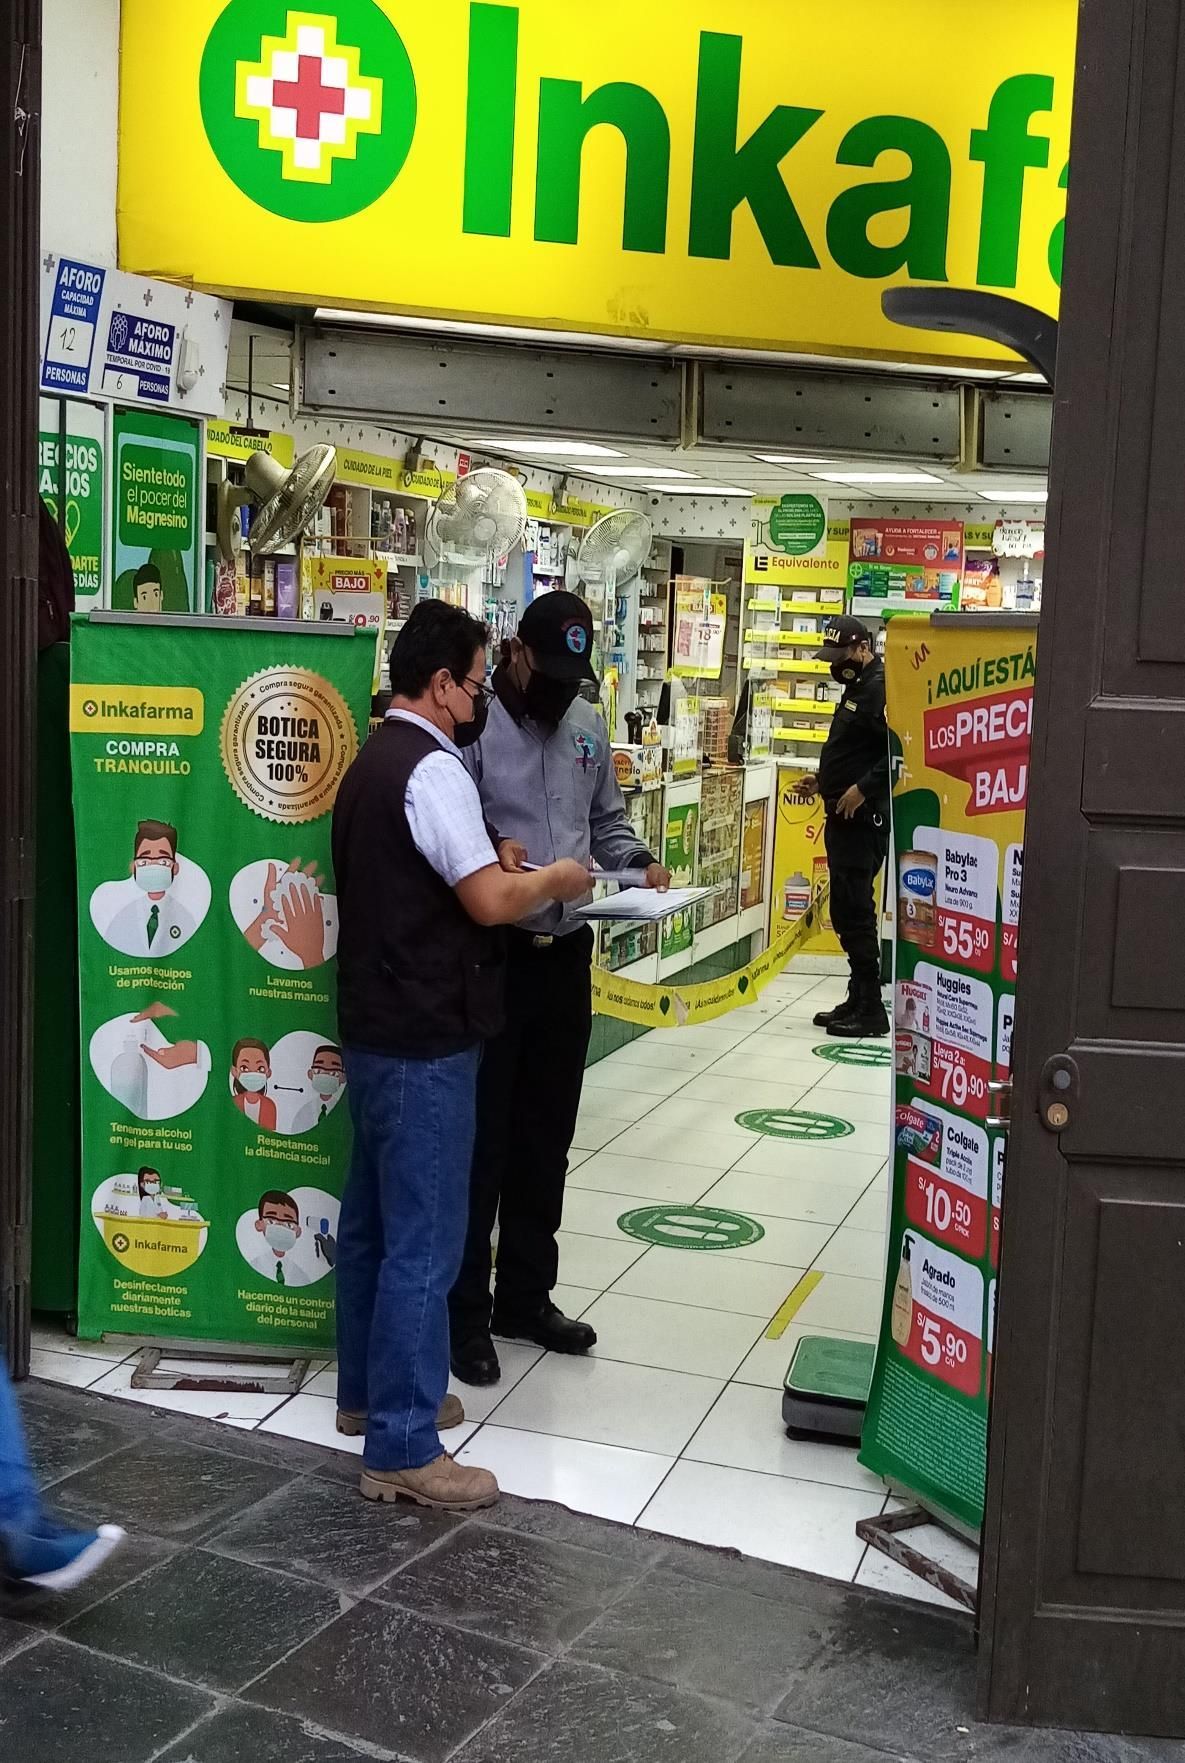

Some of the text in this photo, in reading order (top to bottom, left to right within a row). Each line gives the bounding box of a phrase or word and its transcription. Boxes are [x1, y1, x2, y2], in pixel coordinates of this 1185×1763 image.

[462, 2, 1069, 288] Inkaf
[59, 266, 101, 294] AFORO
[61, 290, 94, 306] CAPACIDAD
[63, 304, 87, 318] MÁXIMA
[59, 327, 75, 351] 12
[133, 321, 170, 342] AFORO
[128, 336, 171, 361] MÁXIMO
[106, 354, 134, 367] TEMPORAL
[134, 359, 146, 370] POR
[146, 361, 162, 373] COVID
[45, 366, 87, 386] PERSONAS
[116, 374, 123, 390] 6
[139, 380, 169, 395] PERSONAS
[230, 434, 242, 447] DEL
[411, 473, 432, 489] CUIDADO
[127, 485, 138, 503] el
[172, 490, 187, 509] del
[79, 571, 98, 588] DÍAS
[335, 576, 366, 590] BAJO
[983, 645, 1035, 687] ESTÁ
[101, 700, 194, 720] Inkafarma
[259, 680, 344, 730] Compra segura garantizada
[257, 715, 320, 739] BOTICA
[929, 725, 955, 750] LOS
[106, 740, 180, 757] COMPRA
[232, 701, 265, 803] Compra segura garantizada
[255, 738, 321, 764] SEGURA
[94, 758, 191, 776] TRANQUILO
[335, 744, 348, 777] Compra
[266, 762, 309, 784] 100%
[277, 793, 321, 812] garantizada
[782, 792, 815, 807] NIDO
[805, 822, 825, 845] S/
[945, 848, 978, 867] Babylac
[945, 866, 967, 882] Pro 3
[909, 903, 914, 916] 3
[109, 965, 192, 980] Usamos equipos
[267, 975, 313, 989] Lavamos
[116, 977, 185, 991] de protección
[936, 971, 971, 995] Huggies
[249, 986, 330, 1003] nuestras manos
[933, 1042, 954, 1061] Lleva
[954, 1052, 960, 1063] 2
[110, 1122, 192, 1140] Tenemos alcohol
[947, 1127, 979, 1154] Colgate
[109, 1135, 192, 1152] en gel para tu uso
[257, 1134, 319, 1153] Respetamos
[245, 1145, 331, 1166] la distancia social
[134, 1238, 188, 1254] Inkafarma
[922, 1259, 956, 1288] Agrado
[113, 1279, 188, 1295] Desinfectamos
[122, 1292, 181, 1306] diariamente
[237, 1289, 335, 1310] Hacemos un control
[111, 1302, 192, 1319] nuestras boticas
[246, 1301, 326, 1320] diario de la salud
[256, 1313, 317, 1329] del personal
